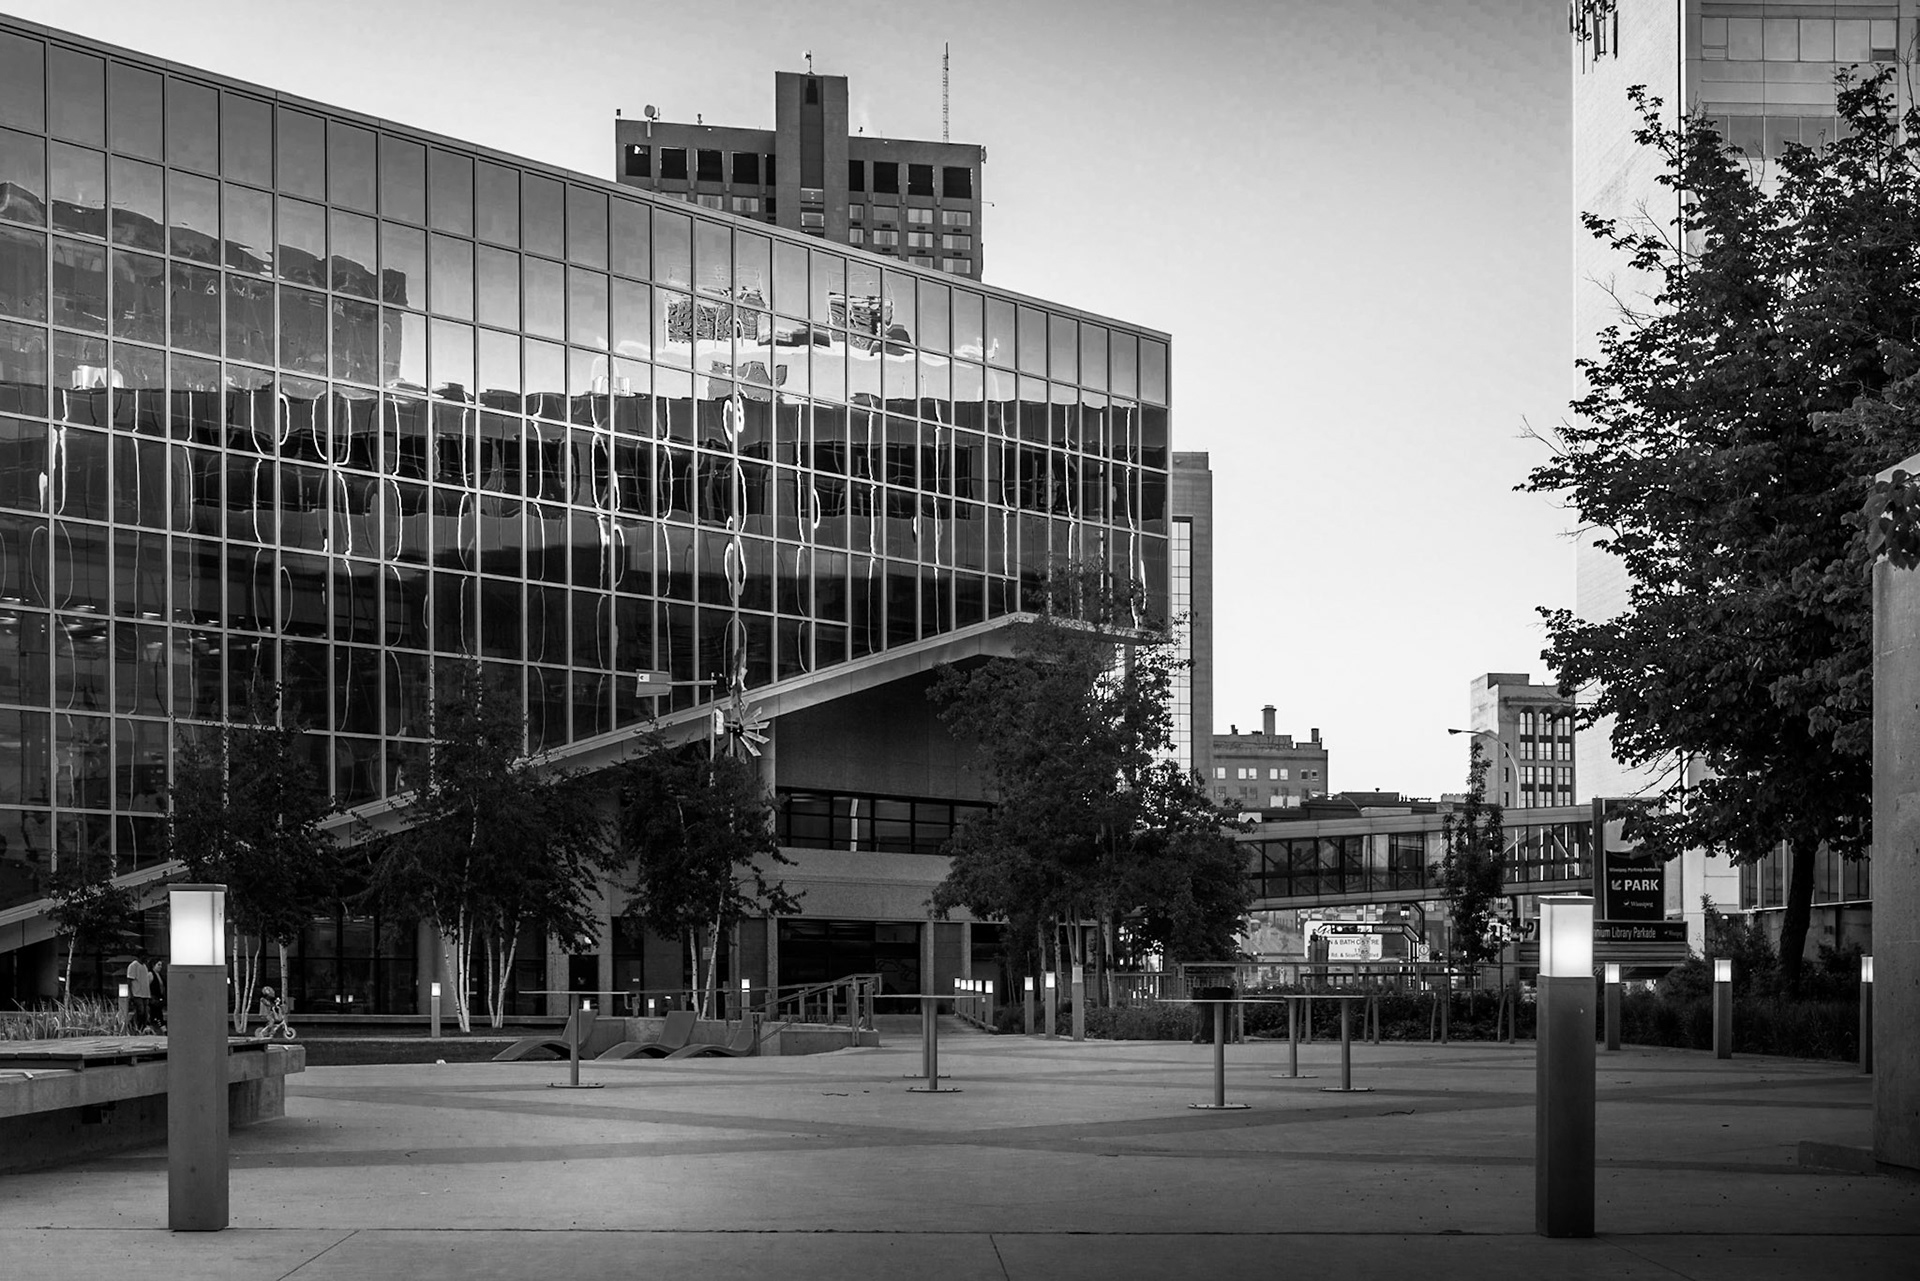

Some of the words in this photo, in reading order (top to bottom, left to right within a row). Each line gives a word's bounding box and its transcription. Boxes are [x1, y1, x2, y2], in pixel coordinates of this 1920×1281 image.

[1624, 879, 1659, 891] PARK
[1611, 926, 1632, 940] Library
[1633, 926, 1656, 938] Parkade
